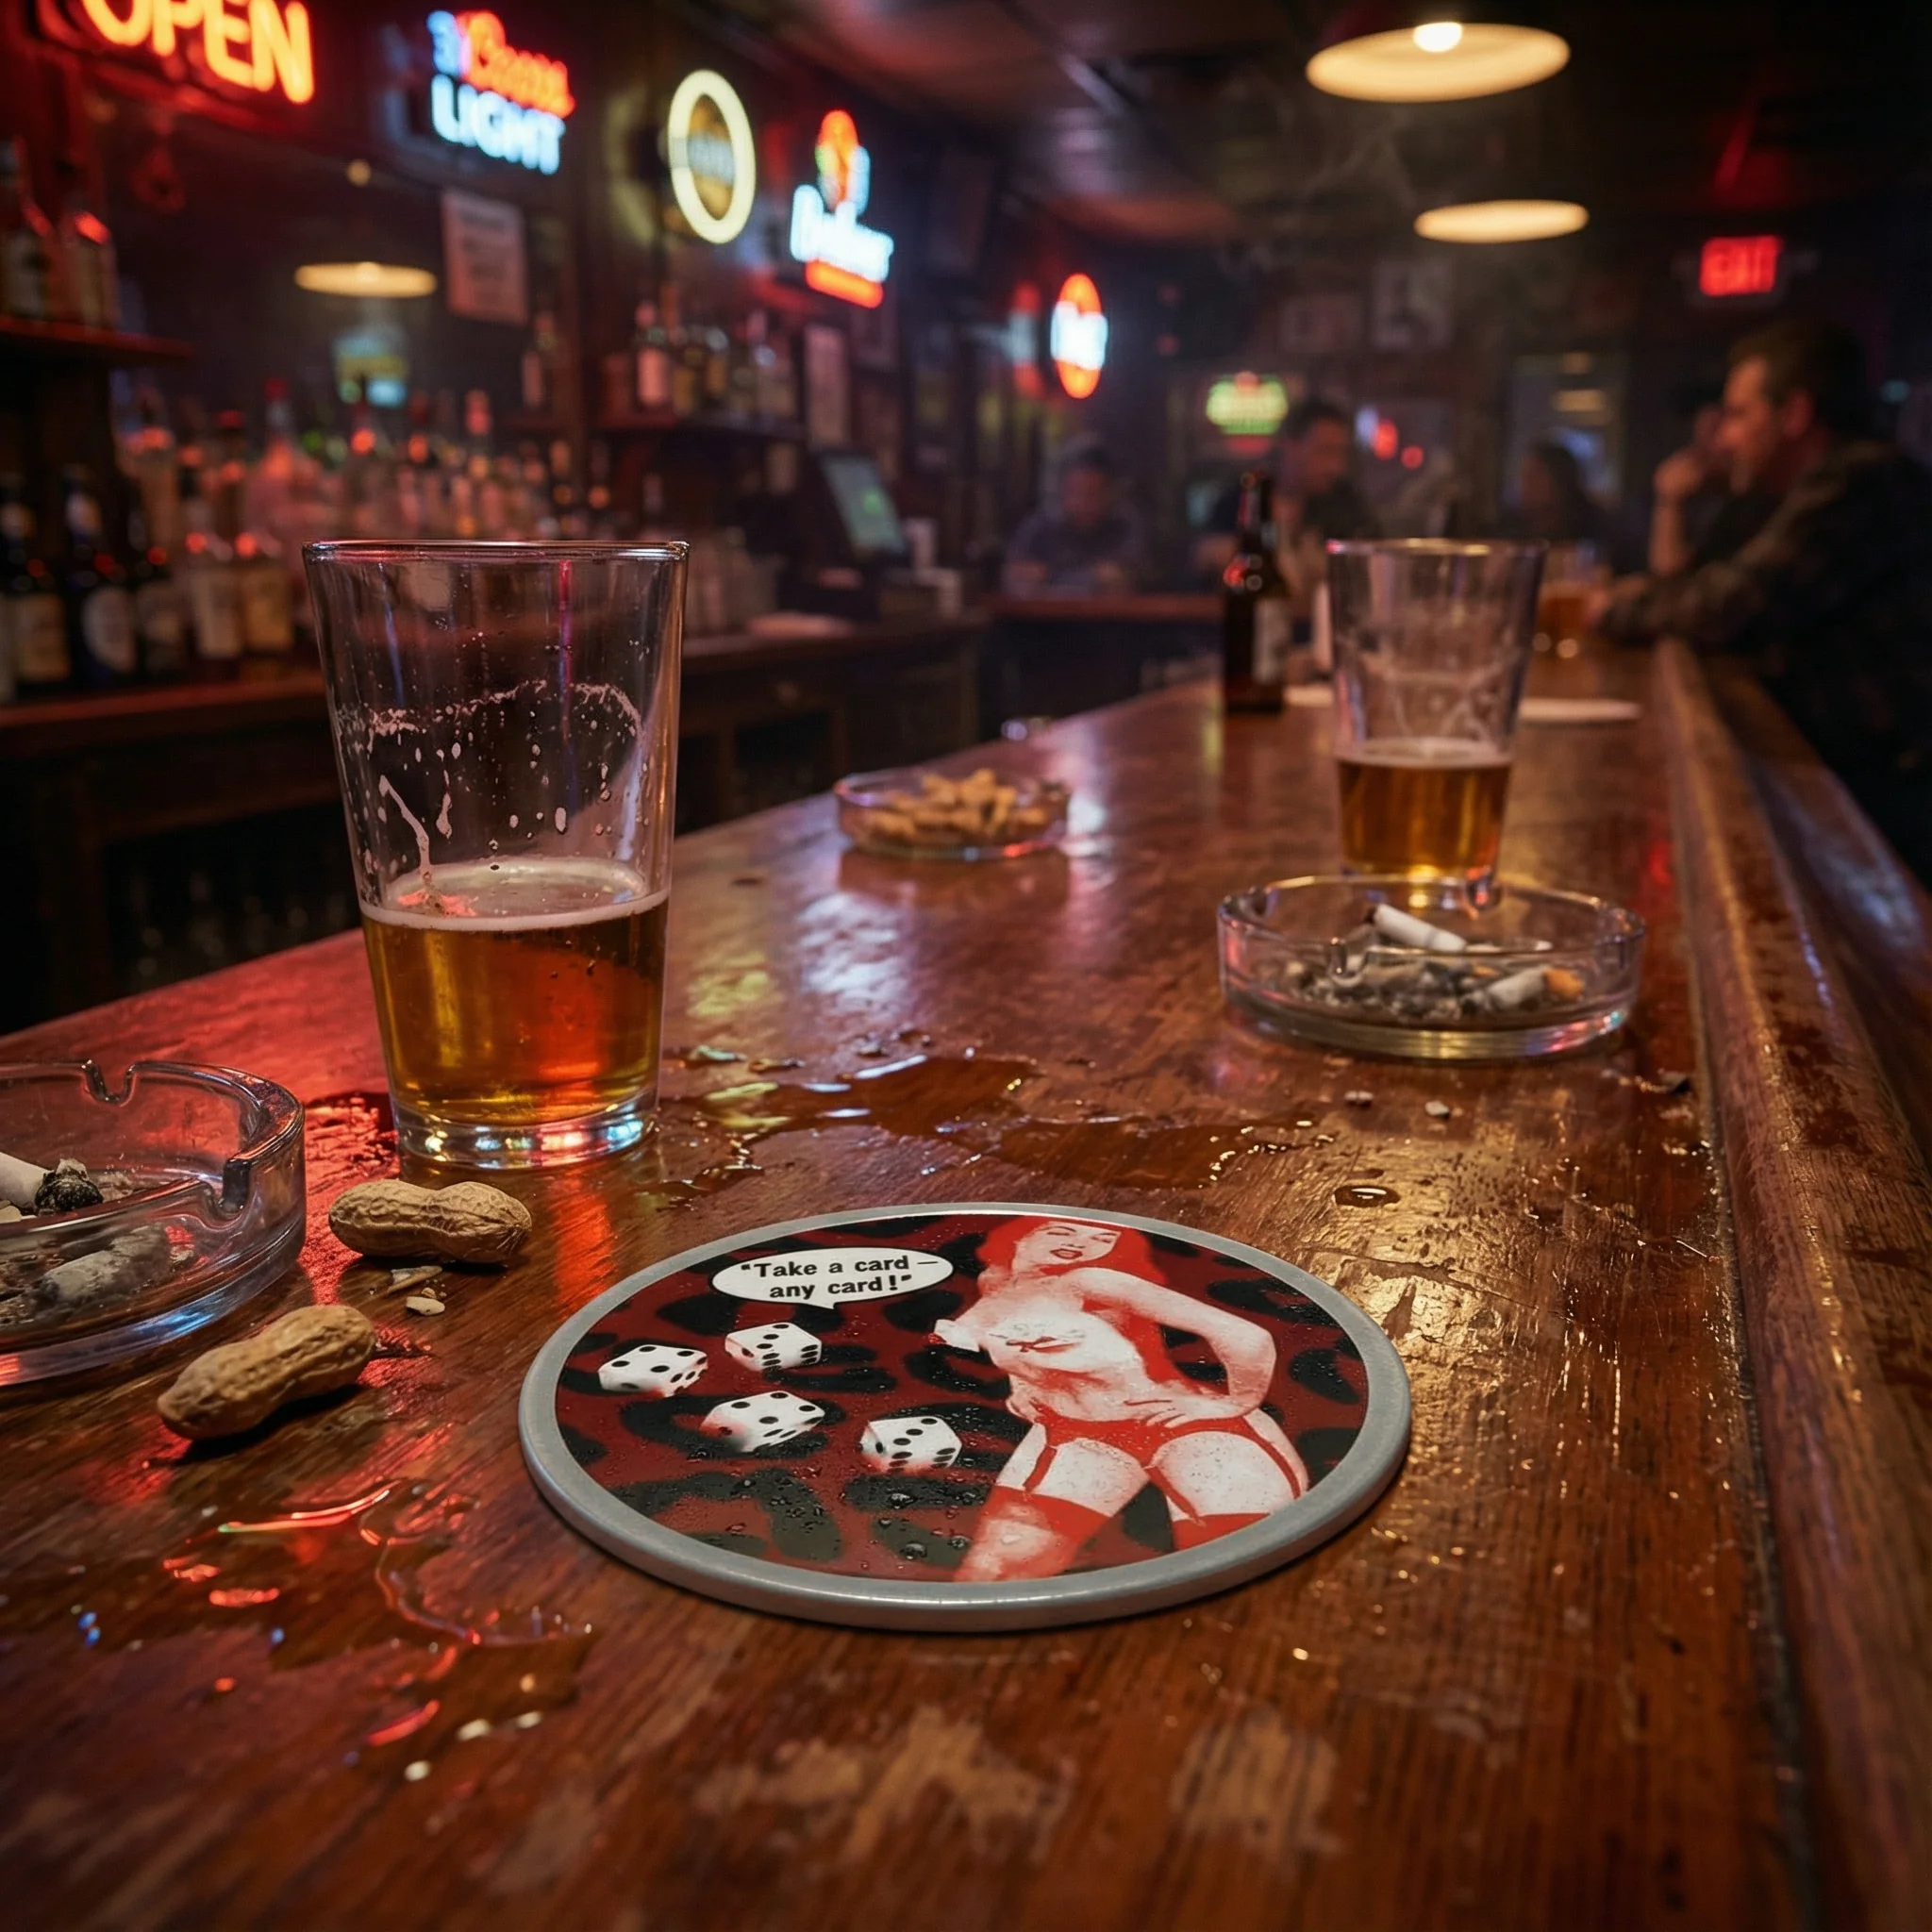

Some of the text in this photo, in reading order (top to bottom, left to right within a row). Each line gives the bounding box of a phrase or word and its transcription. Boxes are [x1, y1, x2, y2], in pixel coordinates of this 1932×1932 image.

[828, 1262, 843, 1274] a
[854, 1255, 909, 1273] card
[769, 1284, 816, 1300] any
